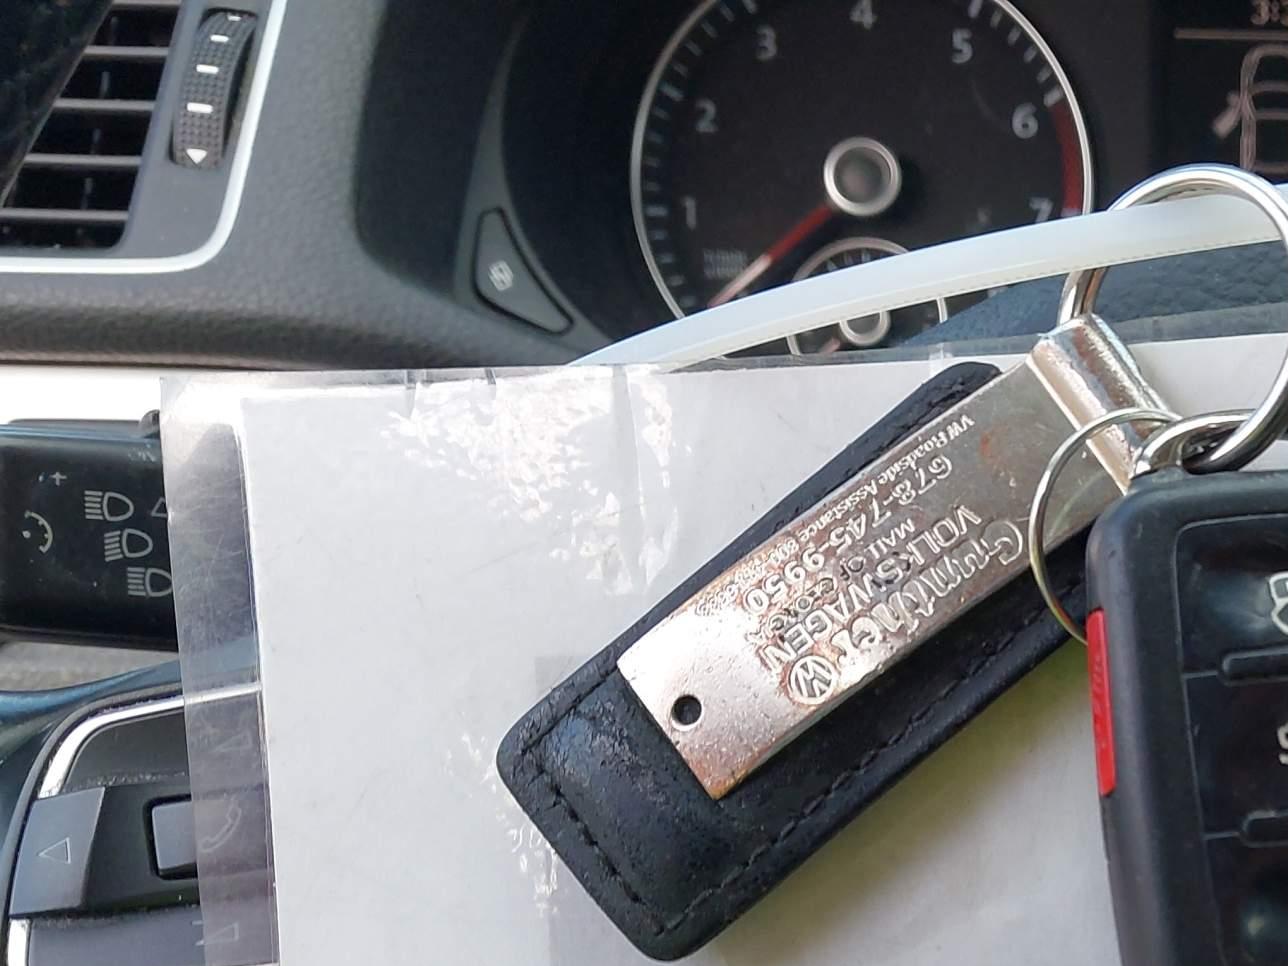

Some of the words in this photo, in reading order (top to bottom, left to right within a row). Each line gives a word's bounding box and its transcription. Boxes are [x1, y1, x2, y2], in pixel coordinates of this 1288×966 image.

[851, 0, 875, 29] 4
[756, 25, 778, 61] 3
[951, 28, 973, 64] 5
[694, 99, 717, 134] 2
[1011, 103, 1038, 139] 6
[684, 197, 697, 228] 1
[946, 414, 975, 436] VW
[878, 431, 949, 485] Roadside
[799, 479, 879, 542] Assistance
[743, 454, 953, 615] 678-745-9950
[864, 517, 917, 559] MALL
[838, 555, 867, 581] OF
[758, 503, 983, 674] VOLKSWAGEN
